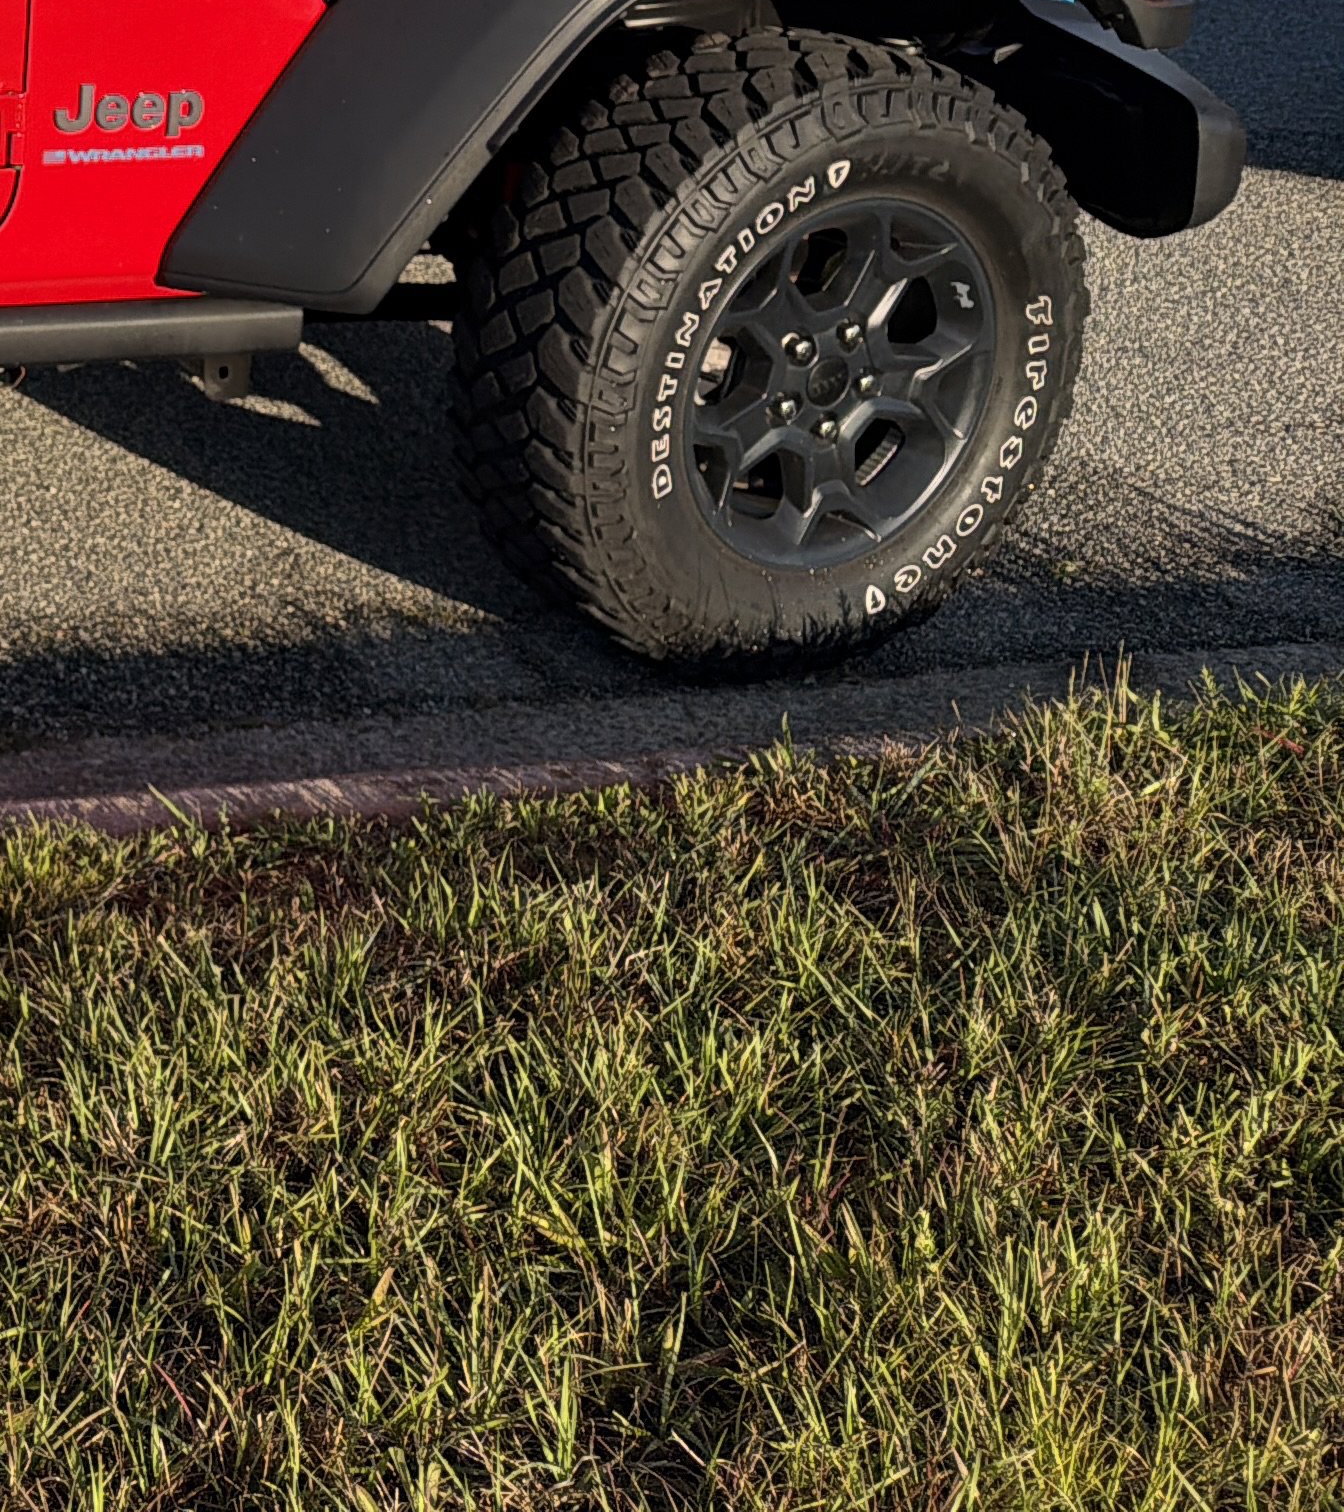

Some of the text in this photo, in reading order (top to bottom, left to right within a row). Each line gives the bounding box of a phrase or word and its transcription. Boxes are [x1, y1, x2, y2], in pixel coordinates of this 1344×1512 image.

[53, 83, 205, 138] Jeep
[66, 144, 205, 164] WRANGLER
[651, 176, 816, 500] DESTINATION
